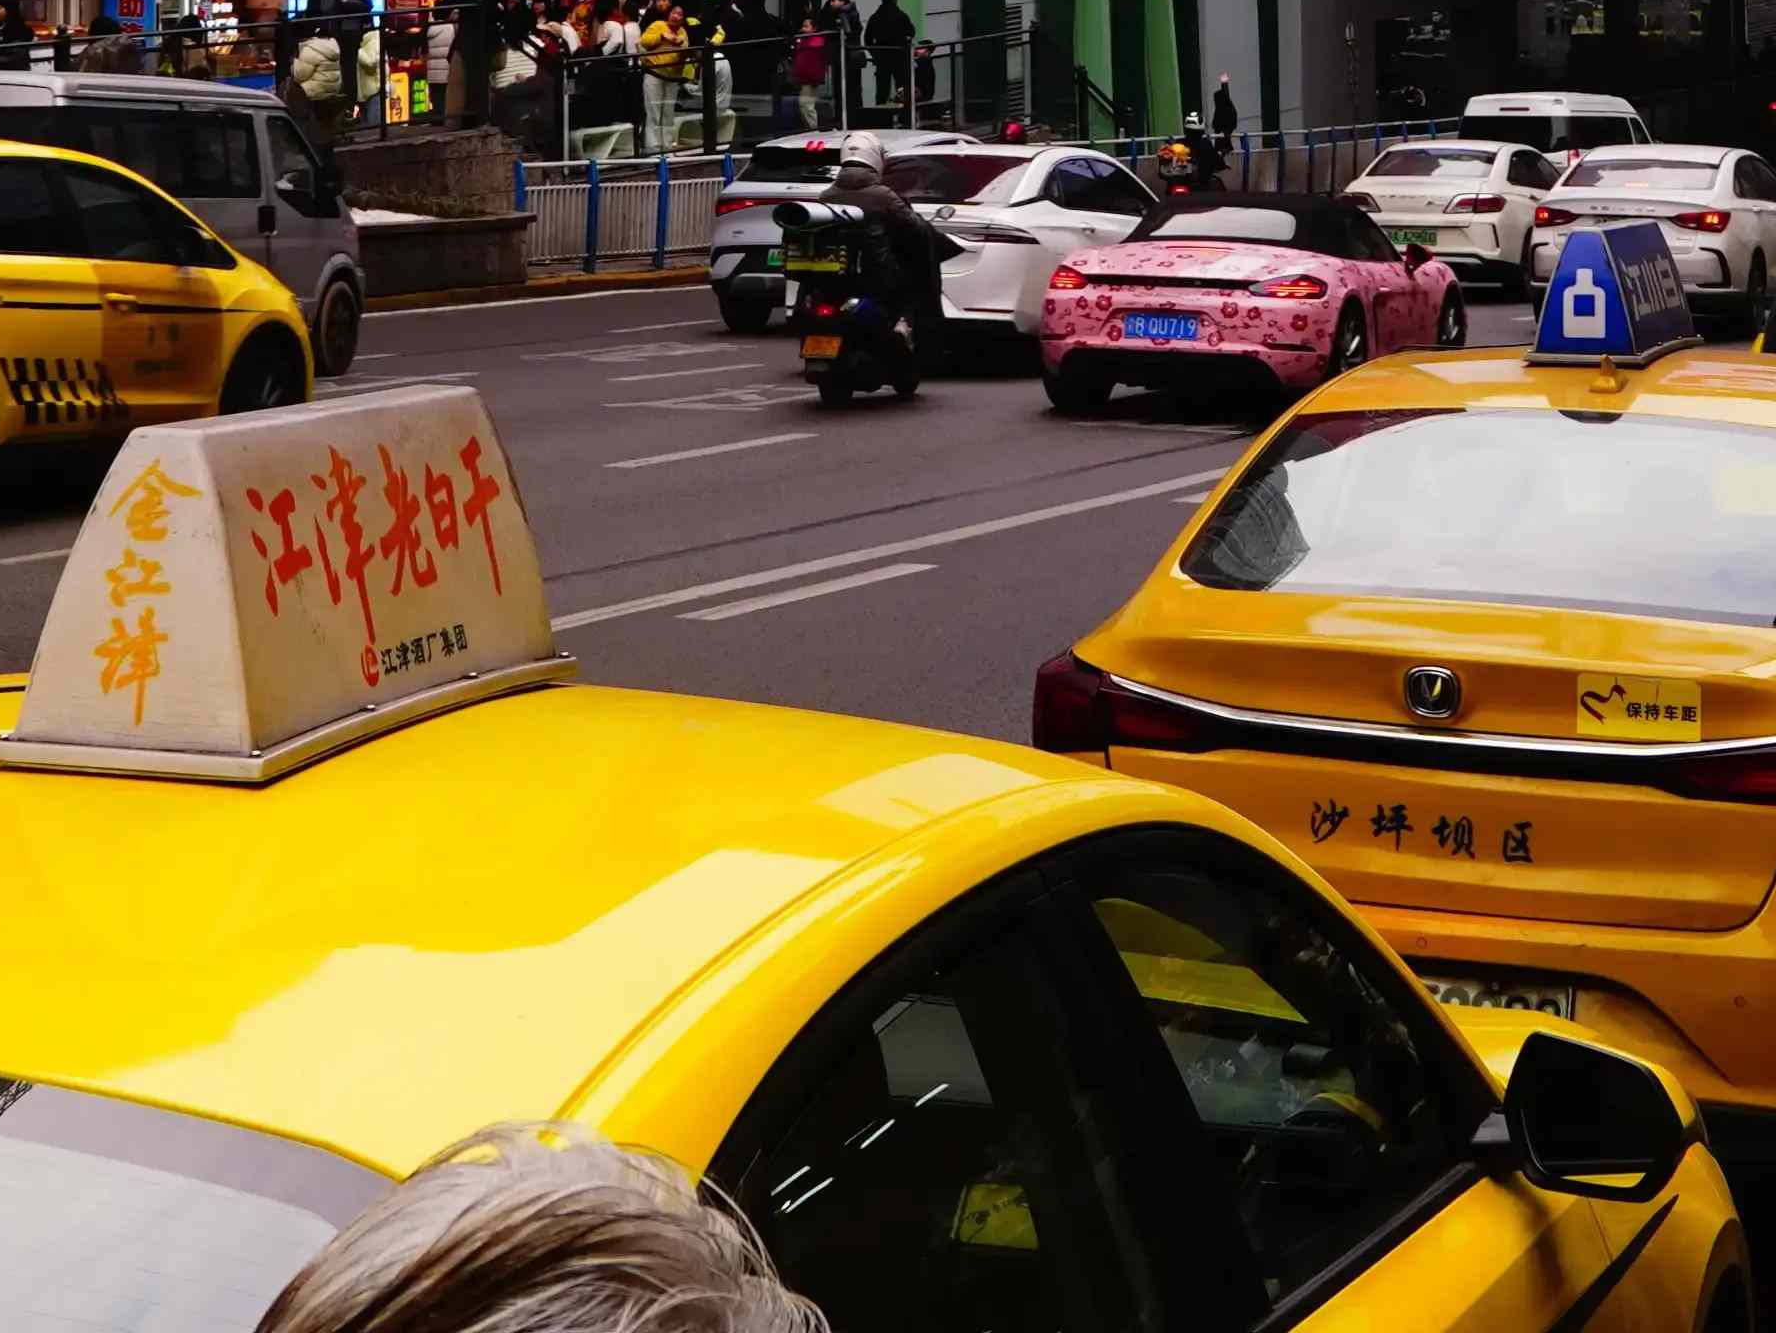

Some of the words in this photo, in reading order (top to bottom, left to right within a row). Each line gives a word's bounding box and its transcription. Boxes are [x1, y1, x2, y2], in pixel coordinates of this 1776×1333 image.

[246, 437, 502, 643] 江津老白干
[93, 458, 204, 725] 金江津
[381, 624, 469, 675] 江津酒厂集团
[1626, 702, 1697, 722] 保持车距
[1311, 799, 1534, 864] 沙坪坝区
